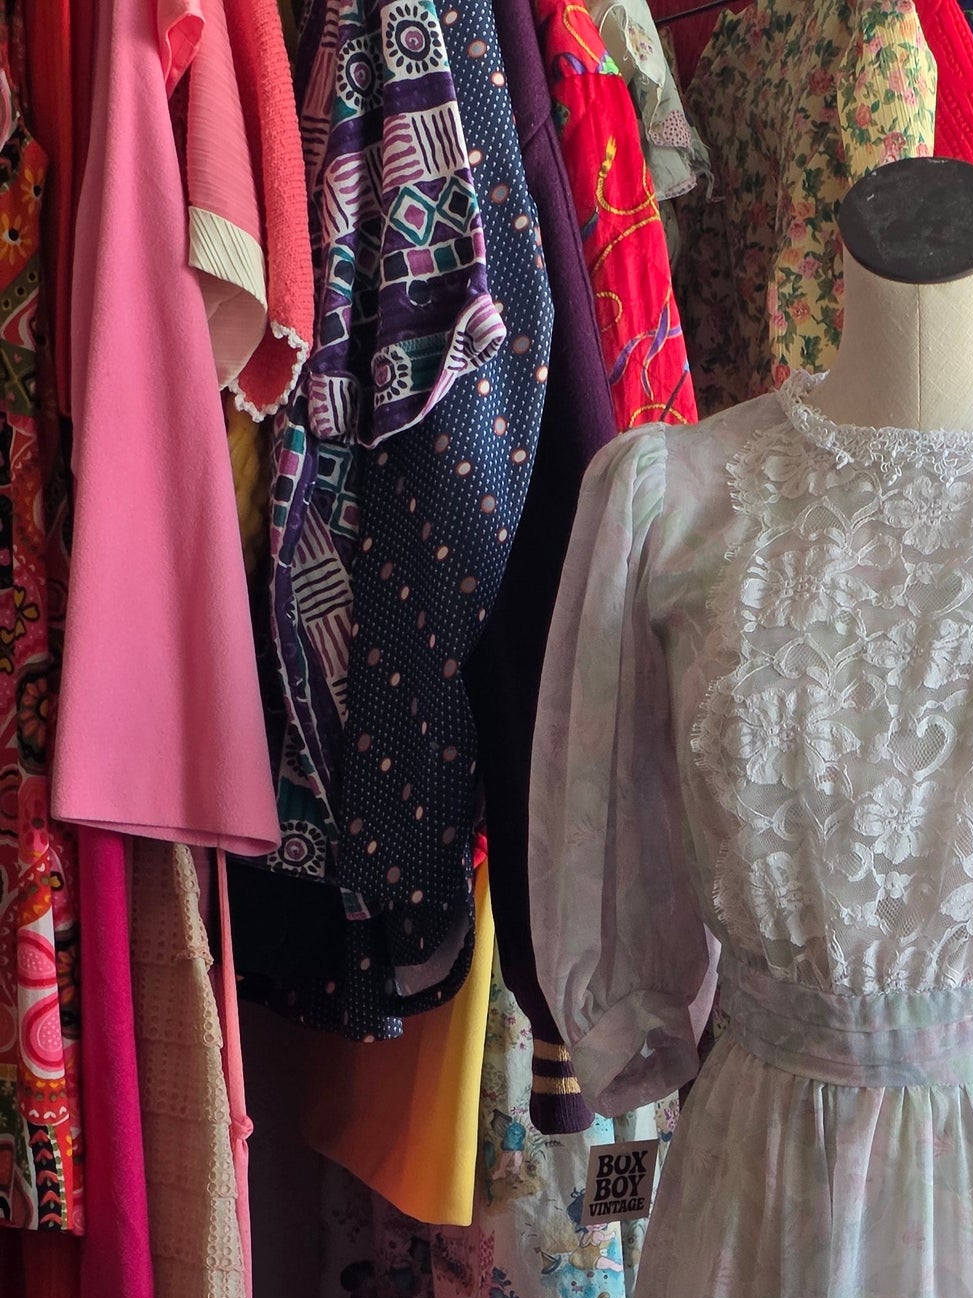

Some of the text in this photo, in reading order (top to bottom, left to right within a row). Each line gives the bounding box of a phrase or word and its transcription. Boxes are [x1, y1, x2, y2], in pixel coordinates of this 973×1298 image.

[596, 1150, 648, 1178] BOX
[593, 1174, 646, 1201] BOY
[589, 1197, 645, 1217] VINTAGE
